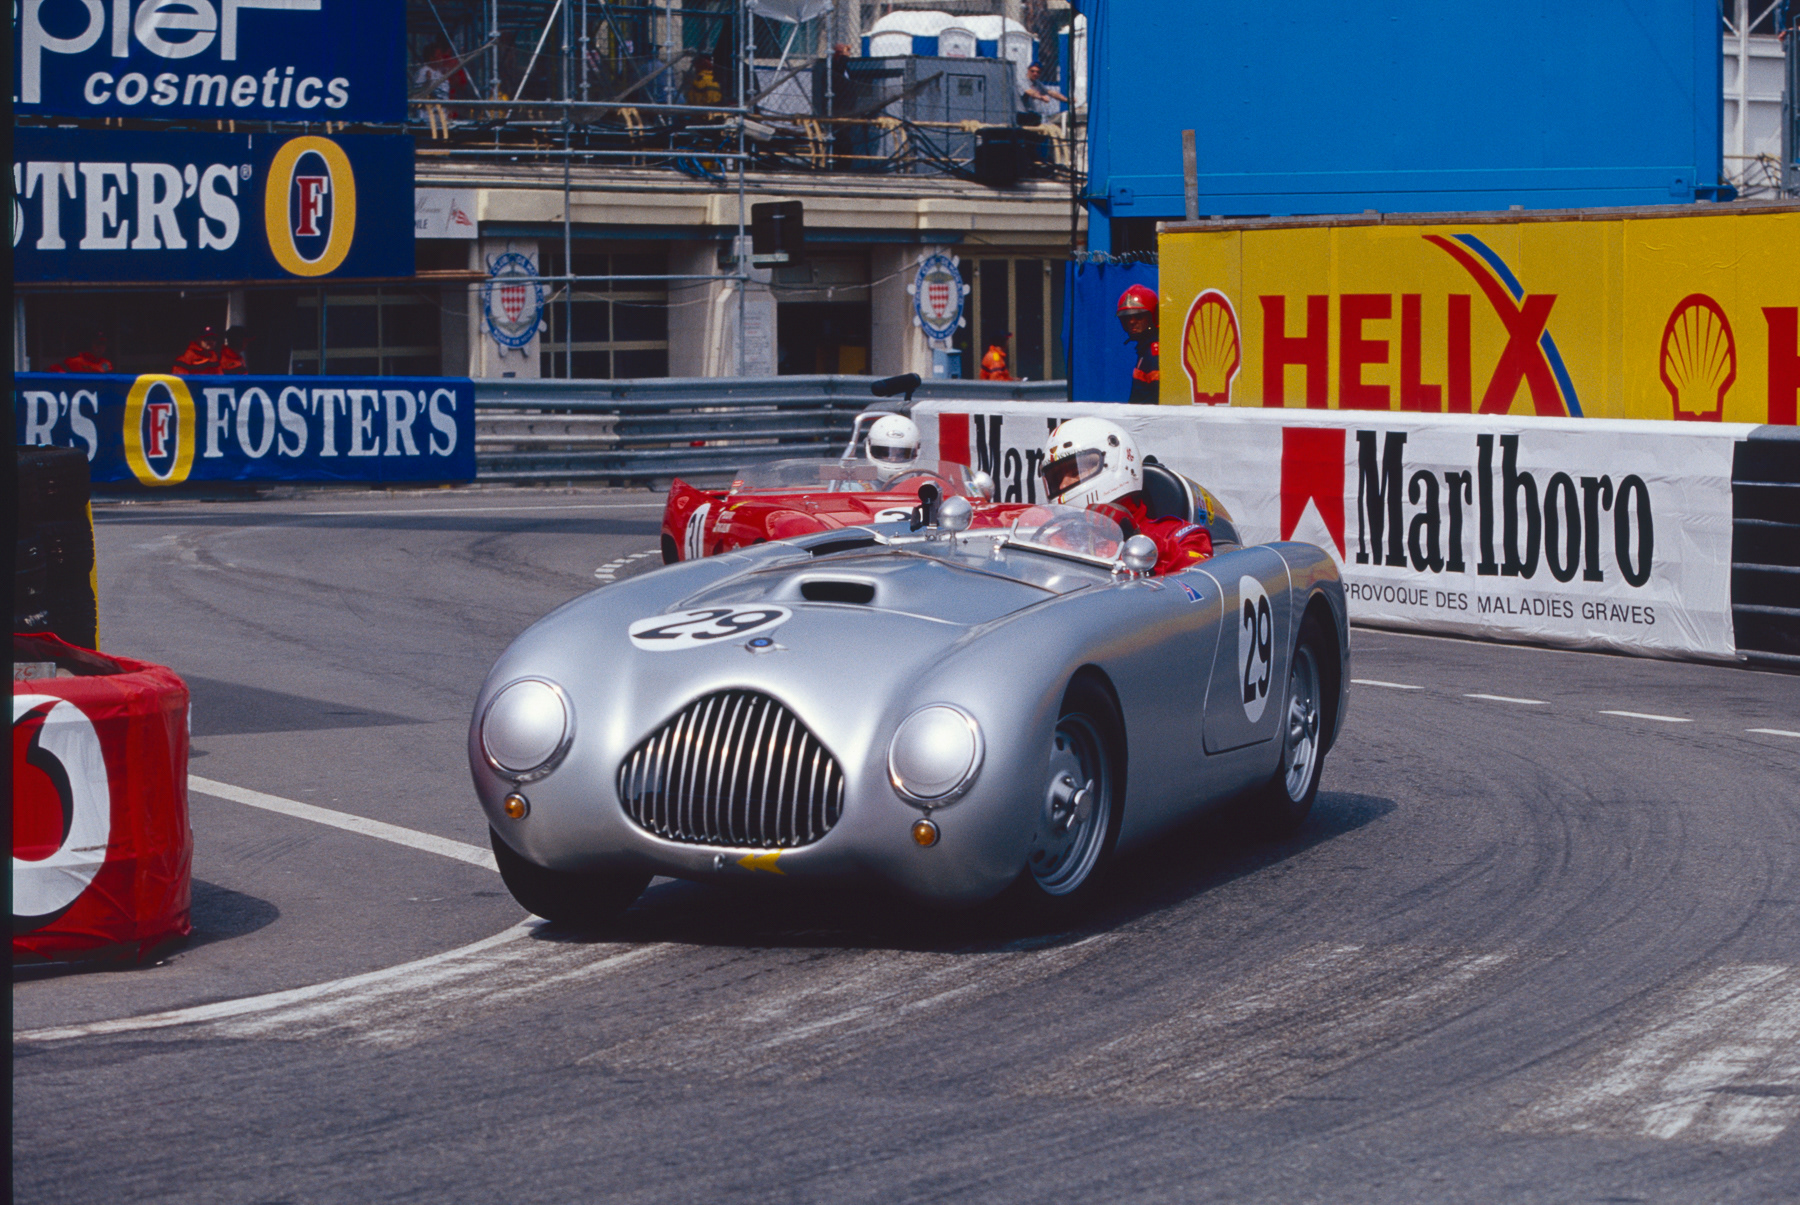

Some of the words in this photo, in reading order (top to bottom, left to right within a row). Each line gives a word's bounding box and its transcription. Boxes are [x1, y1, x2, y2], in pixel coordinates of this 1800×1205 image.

[84, 66, 350, 109] cosmetics
[1258, 234, 1568, 417] HELIX
[203, 385, 458, 459] FOSTER'S
[1356, 429, 1654, 588] Marlboro
[631, 608, 784, 640] 29
[1436, 591, 1468, 611] DES
[1477, 595, 1574, 619] MALADIES
[1581, 601, 1656, 625] GRAVES
[1243, 594, 1272, 705] 29
